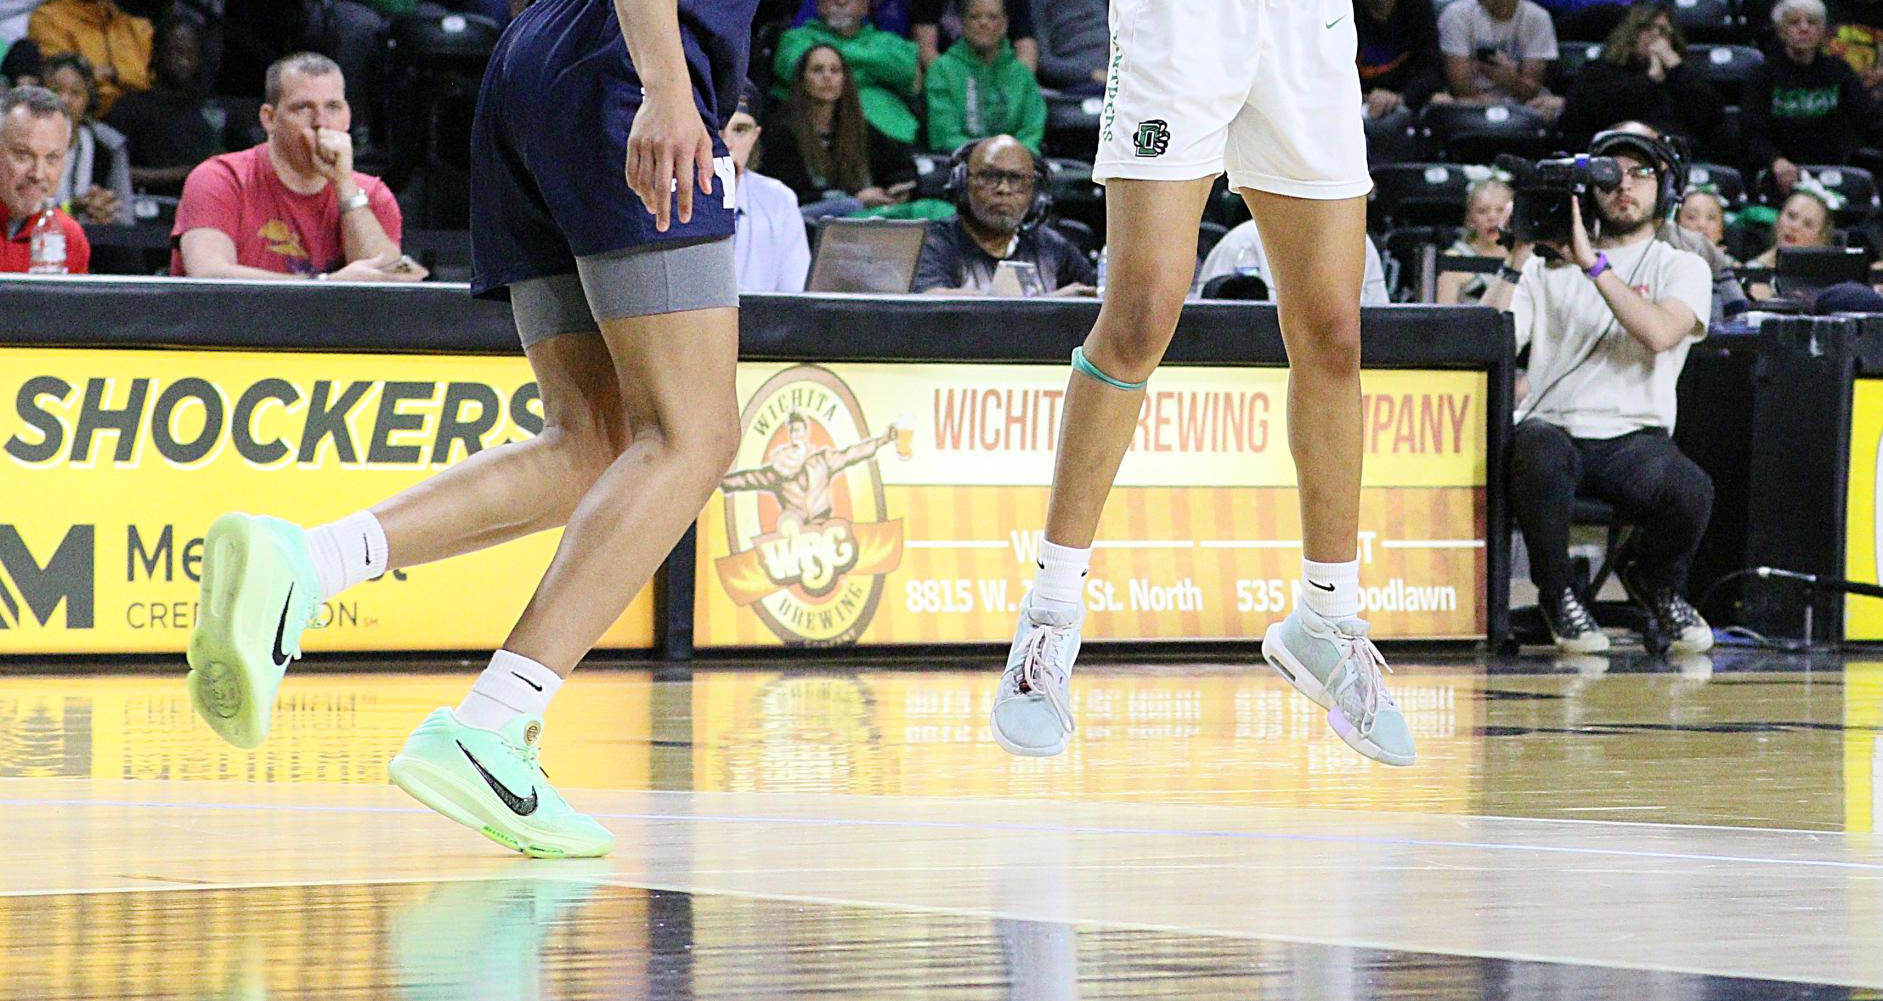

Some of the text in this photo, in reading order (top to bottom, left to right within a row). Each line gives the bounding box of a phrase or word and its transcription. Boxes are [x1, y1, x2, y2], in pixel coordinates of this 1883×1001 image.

[753, 388, 838, 435] WICHITA
[933, 387, 1471, 454] WICHIT REWING PANY
[779, 583, 863, 631] BREWING
[905, 578, 974, 613] 8815
[979, 579, 1017, 613] W.
[1087, 578, 1123, 612] St.
[1129, 577, 1203, 612] North
[1236, 578, 1285, 612] 535
[1356, 578, 1457, 612] oodlawn
